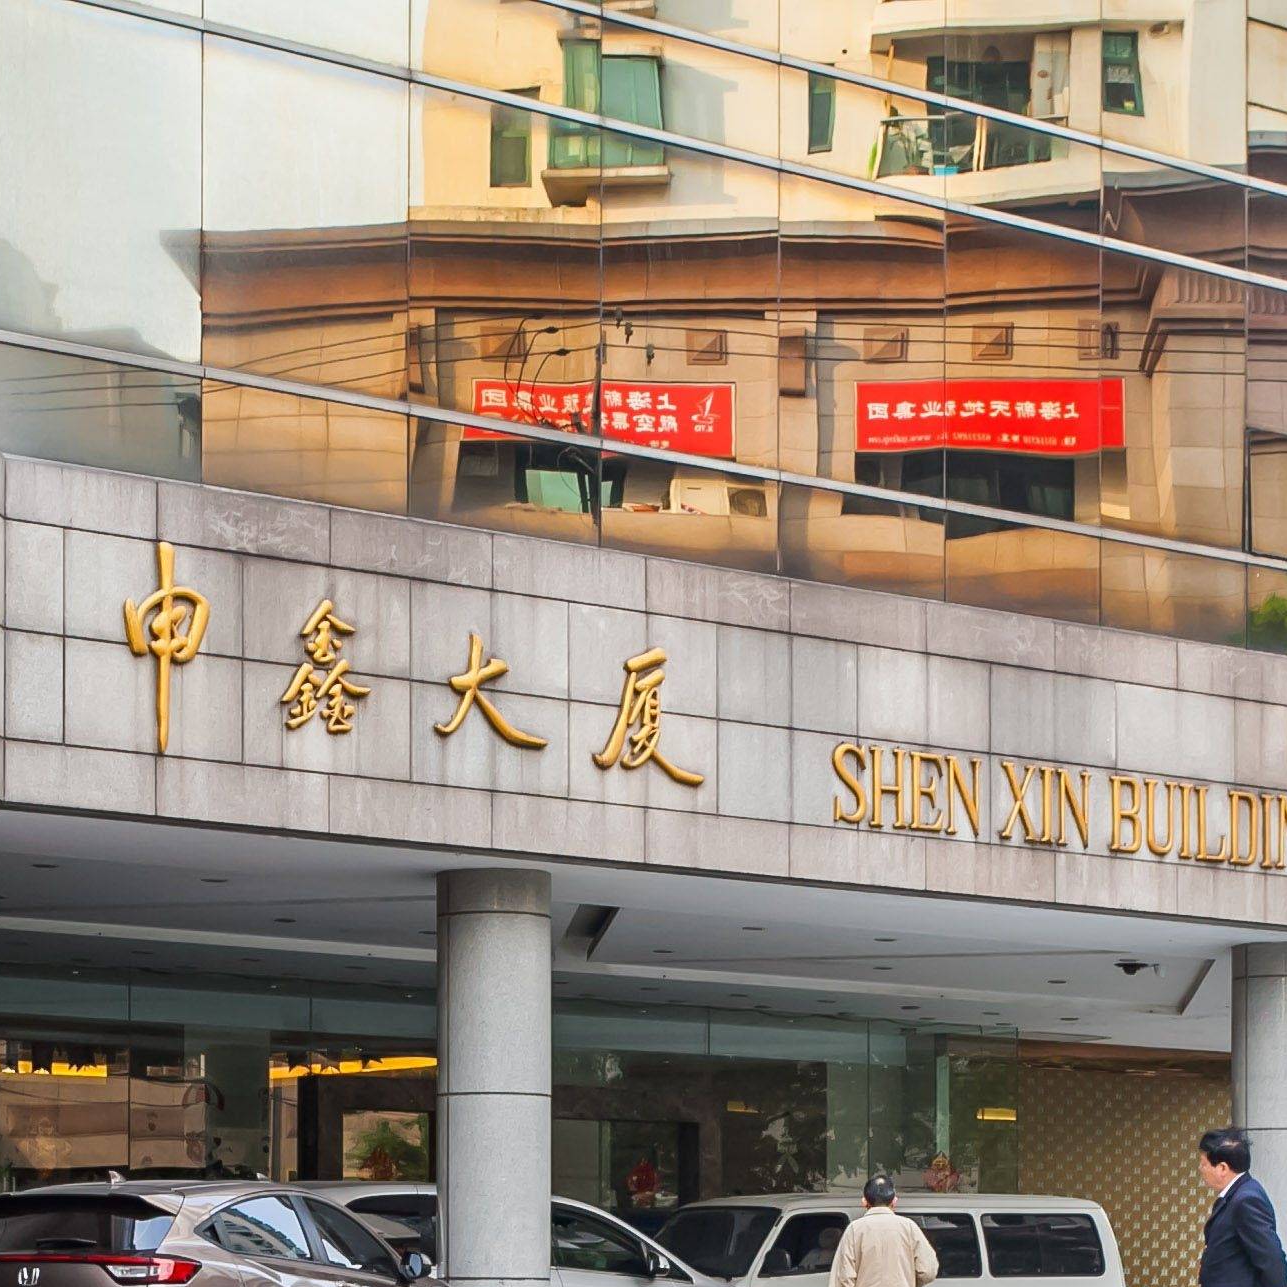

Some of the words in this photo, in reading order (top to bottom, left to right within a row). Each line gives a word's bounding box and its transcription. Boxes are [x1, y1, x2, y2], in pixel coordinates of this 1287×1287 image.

[124, 541, 704, 786] 申鑫大厦
[832, 742, 981, 837] SHEN
[1001, 759, 1091, 849] XIN
